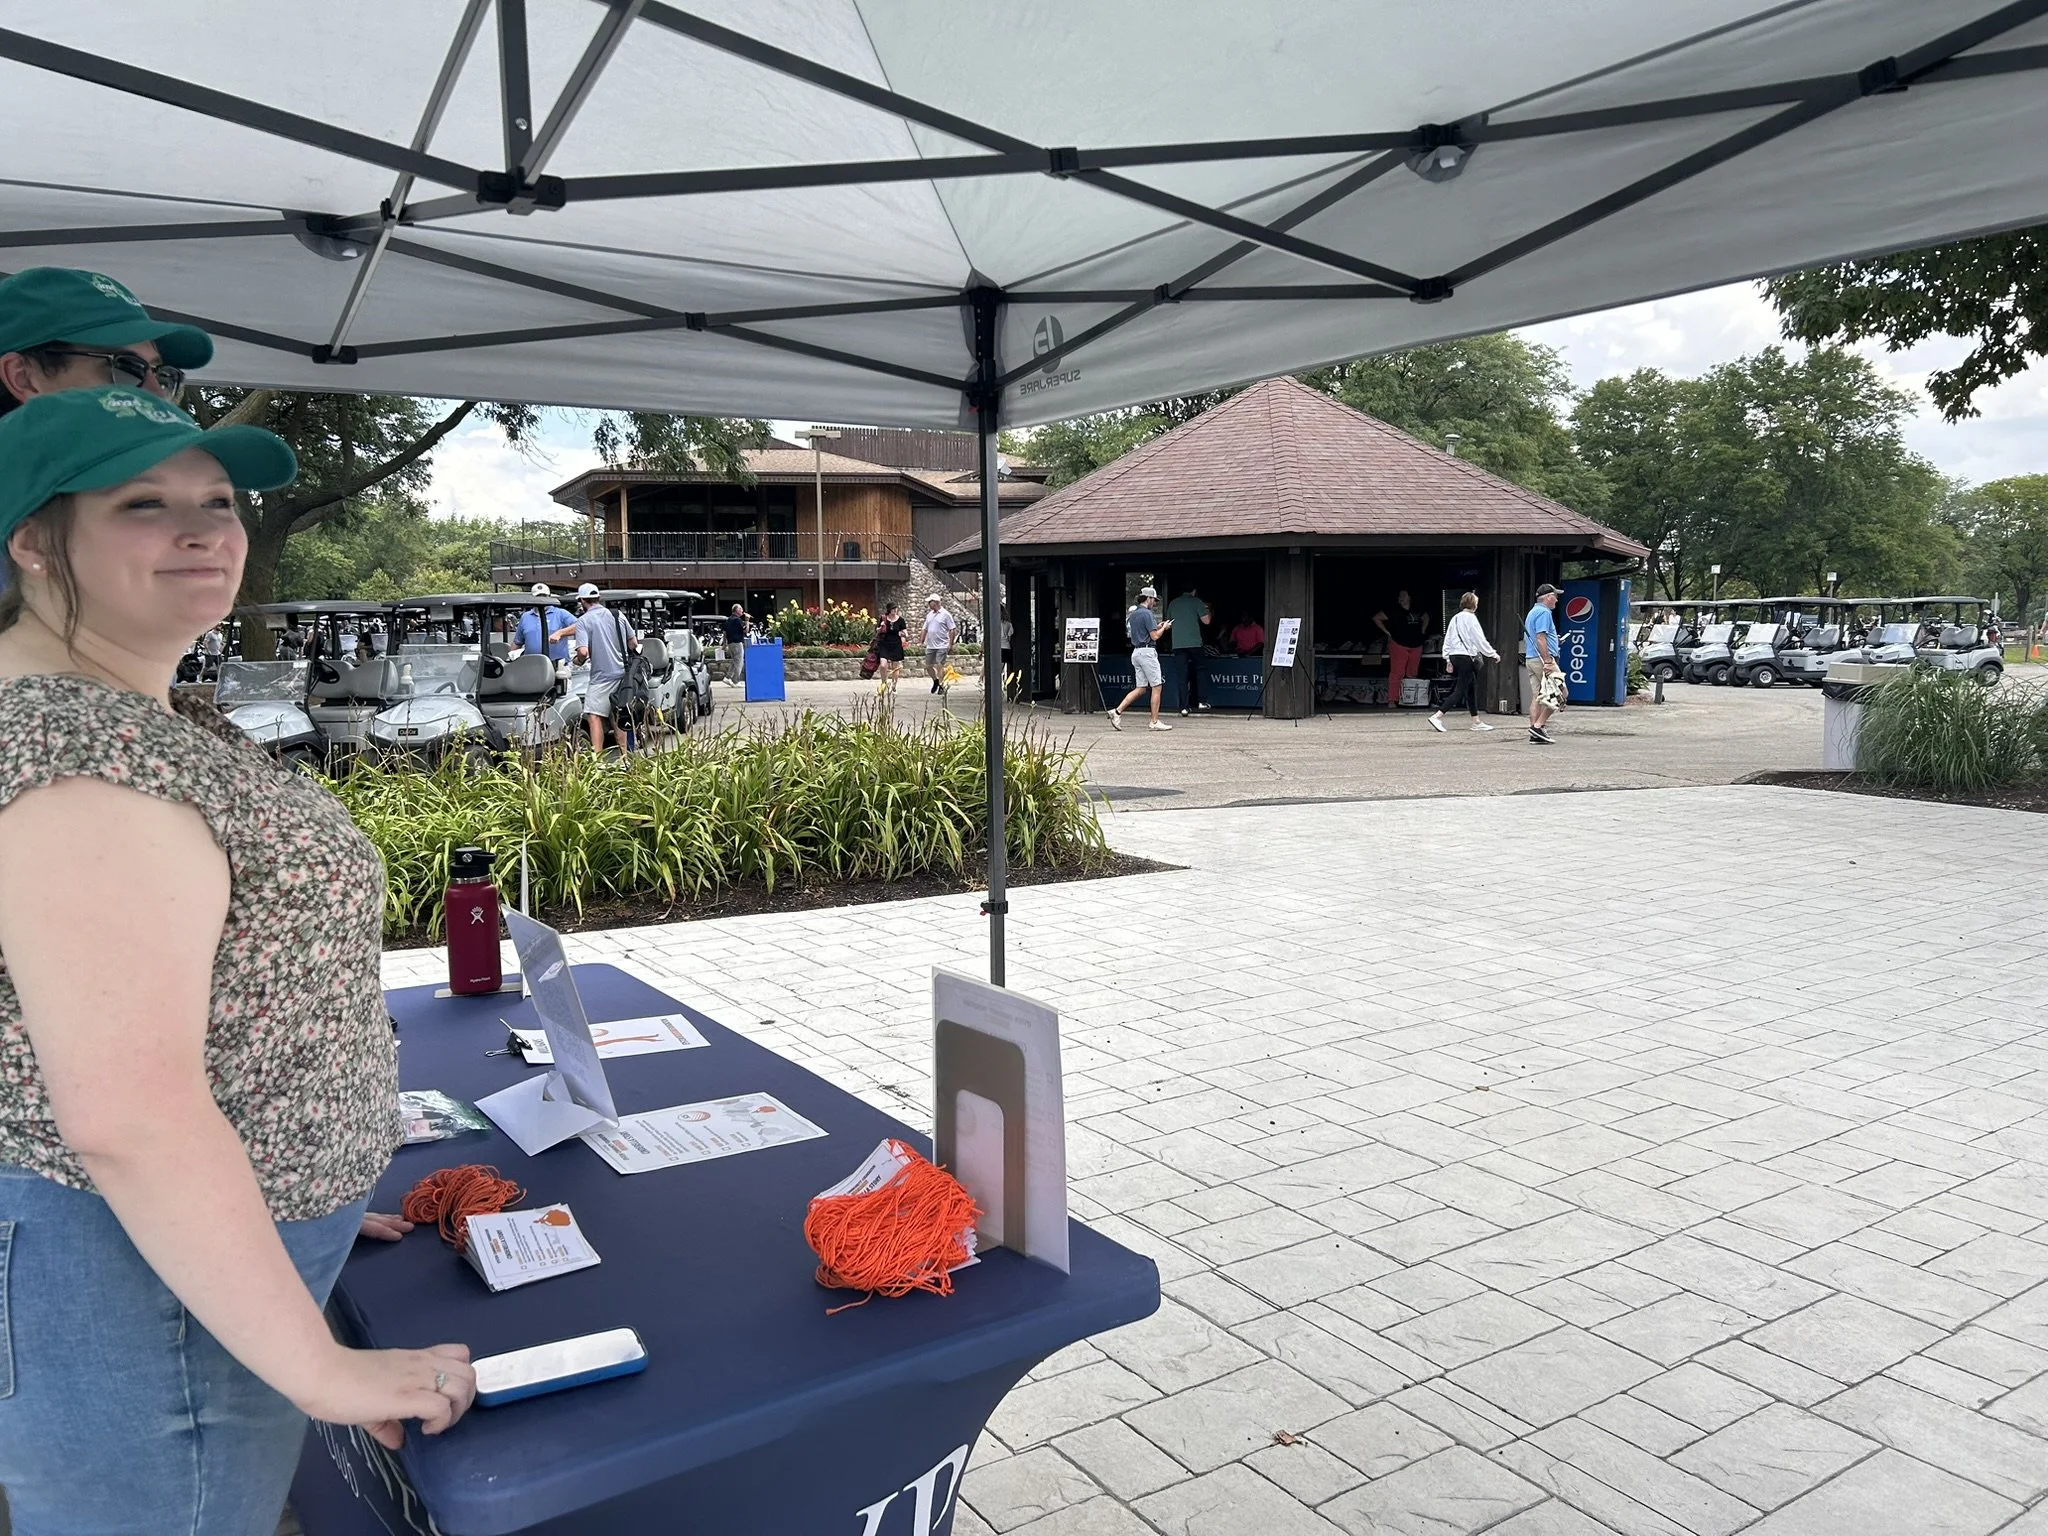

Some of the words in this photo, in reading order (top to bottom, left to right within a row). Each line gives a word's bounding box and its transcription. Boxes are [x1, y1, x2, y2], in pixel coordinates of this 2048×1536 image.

[1569, 629, 1588, 684] pepsi
[1098, 674, 1132, 683] WHITE
[1210, 674, 1248, 683] WHITE
